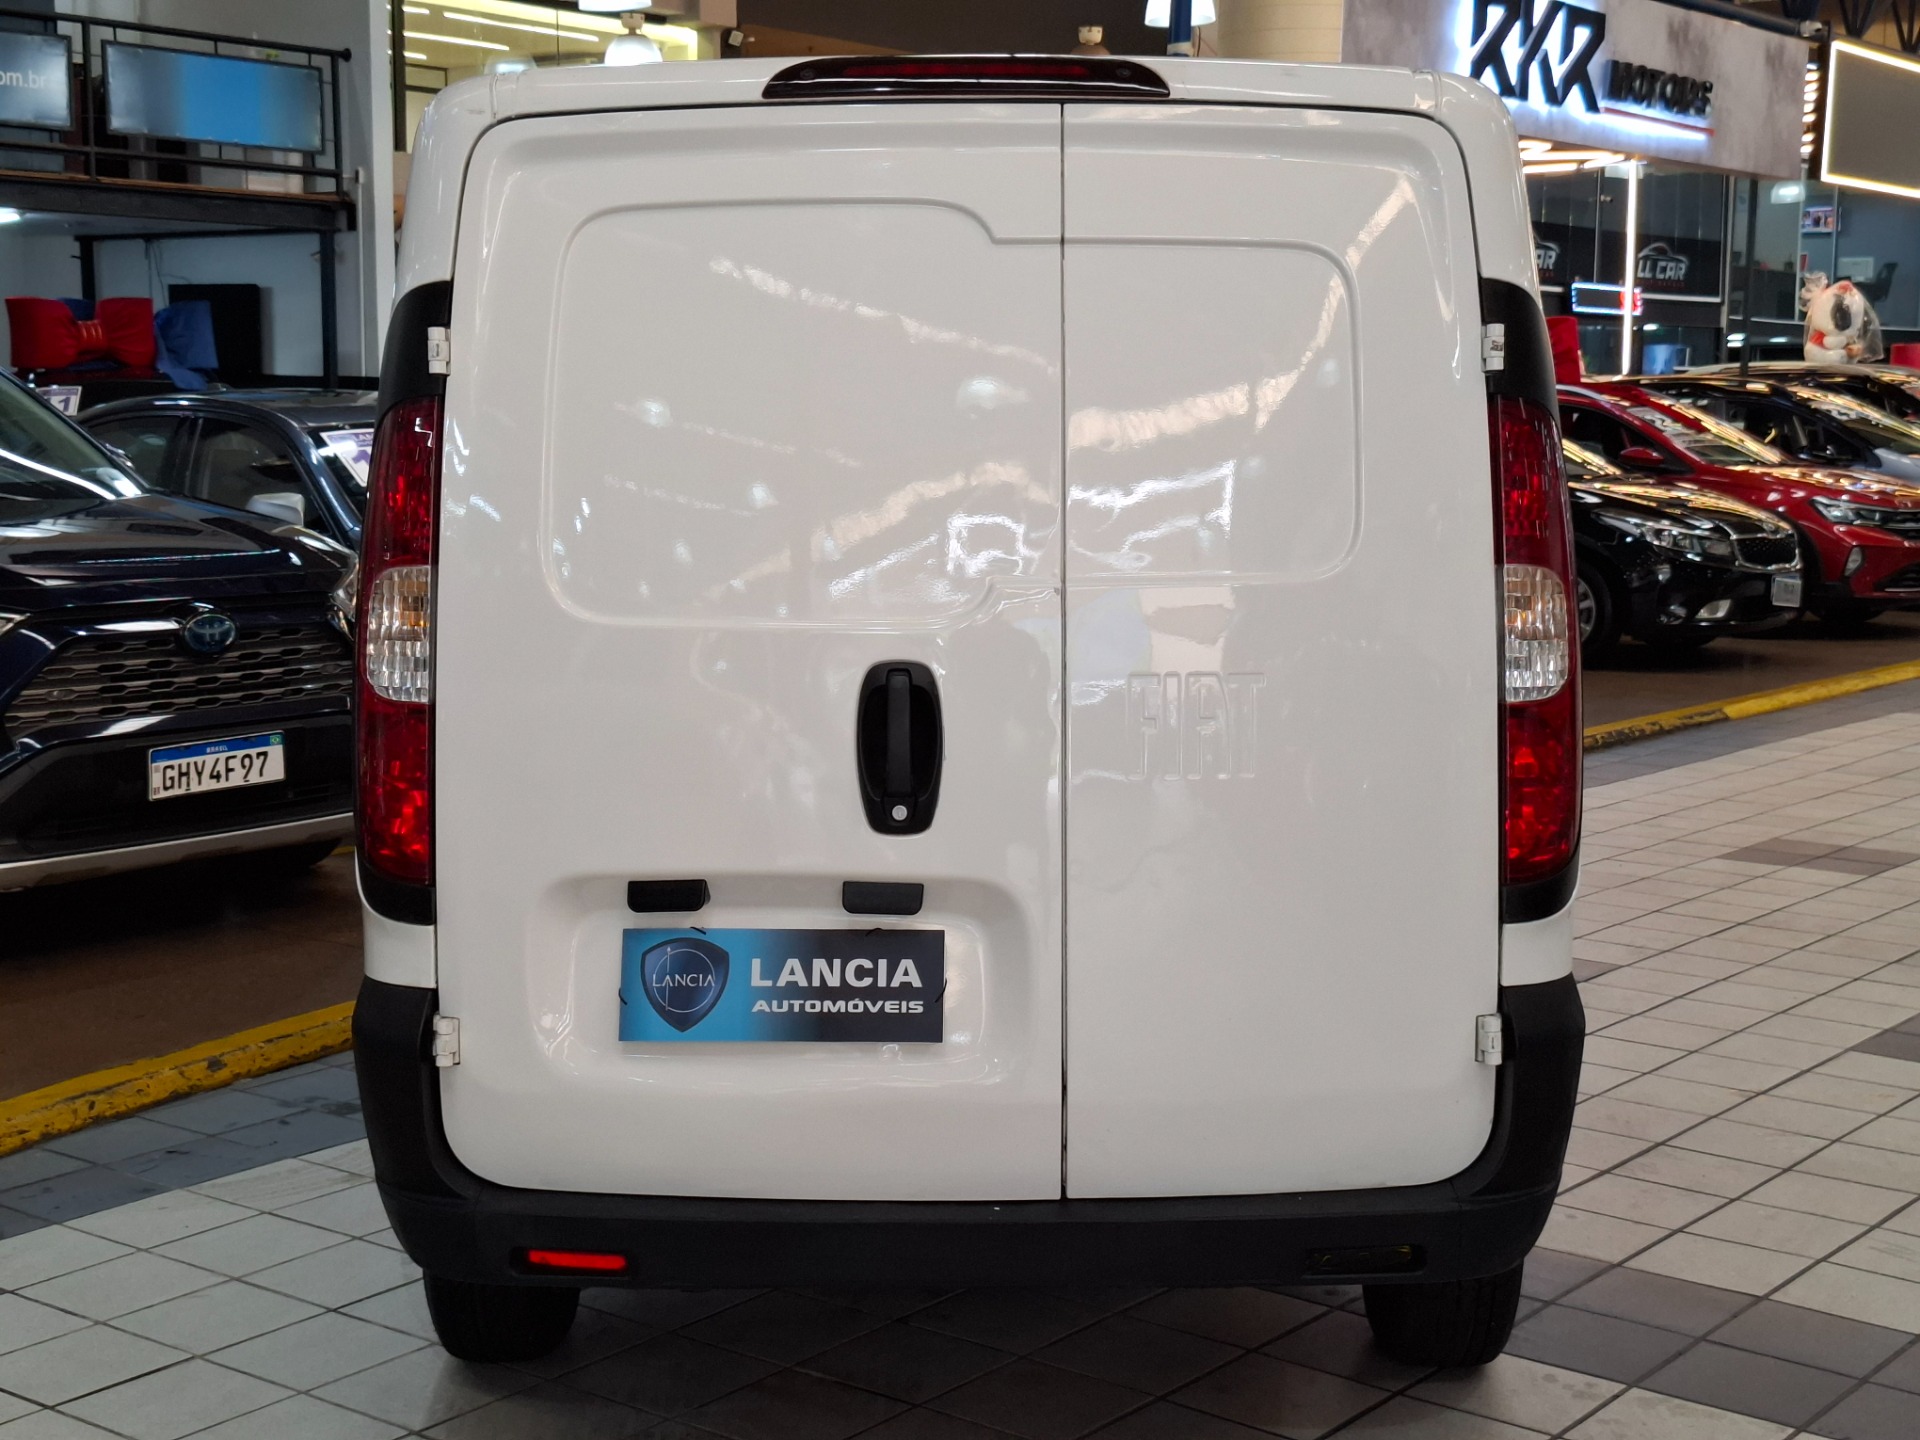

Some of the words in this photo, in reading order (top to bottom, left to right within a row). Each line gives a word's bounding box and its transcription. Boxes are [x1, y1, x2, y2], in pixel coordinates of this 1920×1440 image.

[1603, 59, 1713, 117] MOTORS
[1535, 249, 1557, 270] AR
[1655, 260, 1686, 281] CAR
[1126, 672, 1266, 780] FIAT
[162, 751, 269, 791] GHY4F97
[653, 973, 715, 987] LANCIA
[751, 958, 923, 988] LANCIA
[751, 997, 924, 1014] AUTOMÓVEIS
